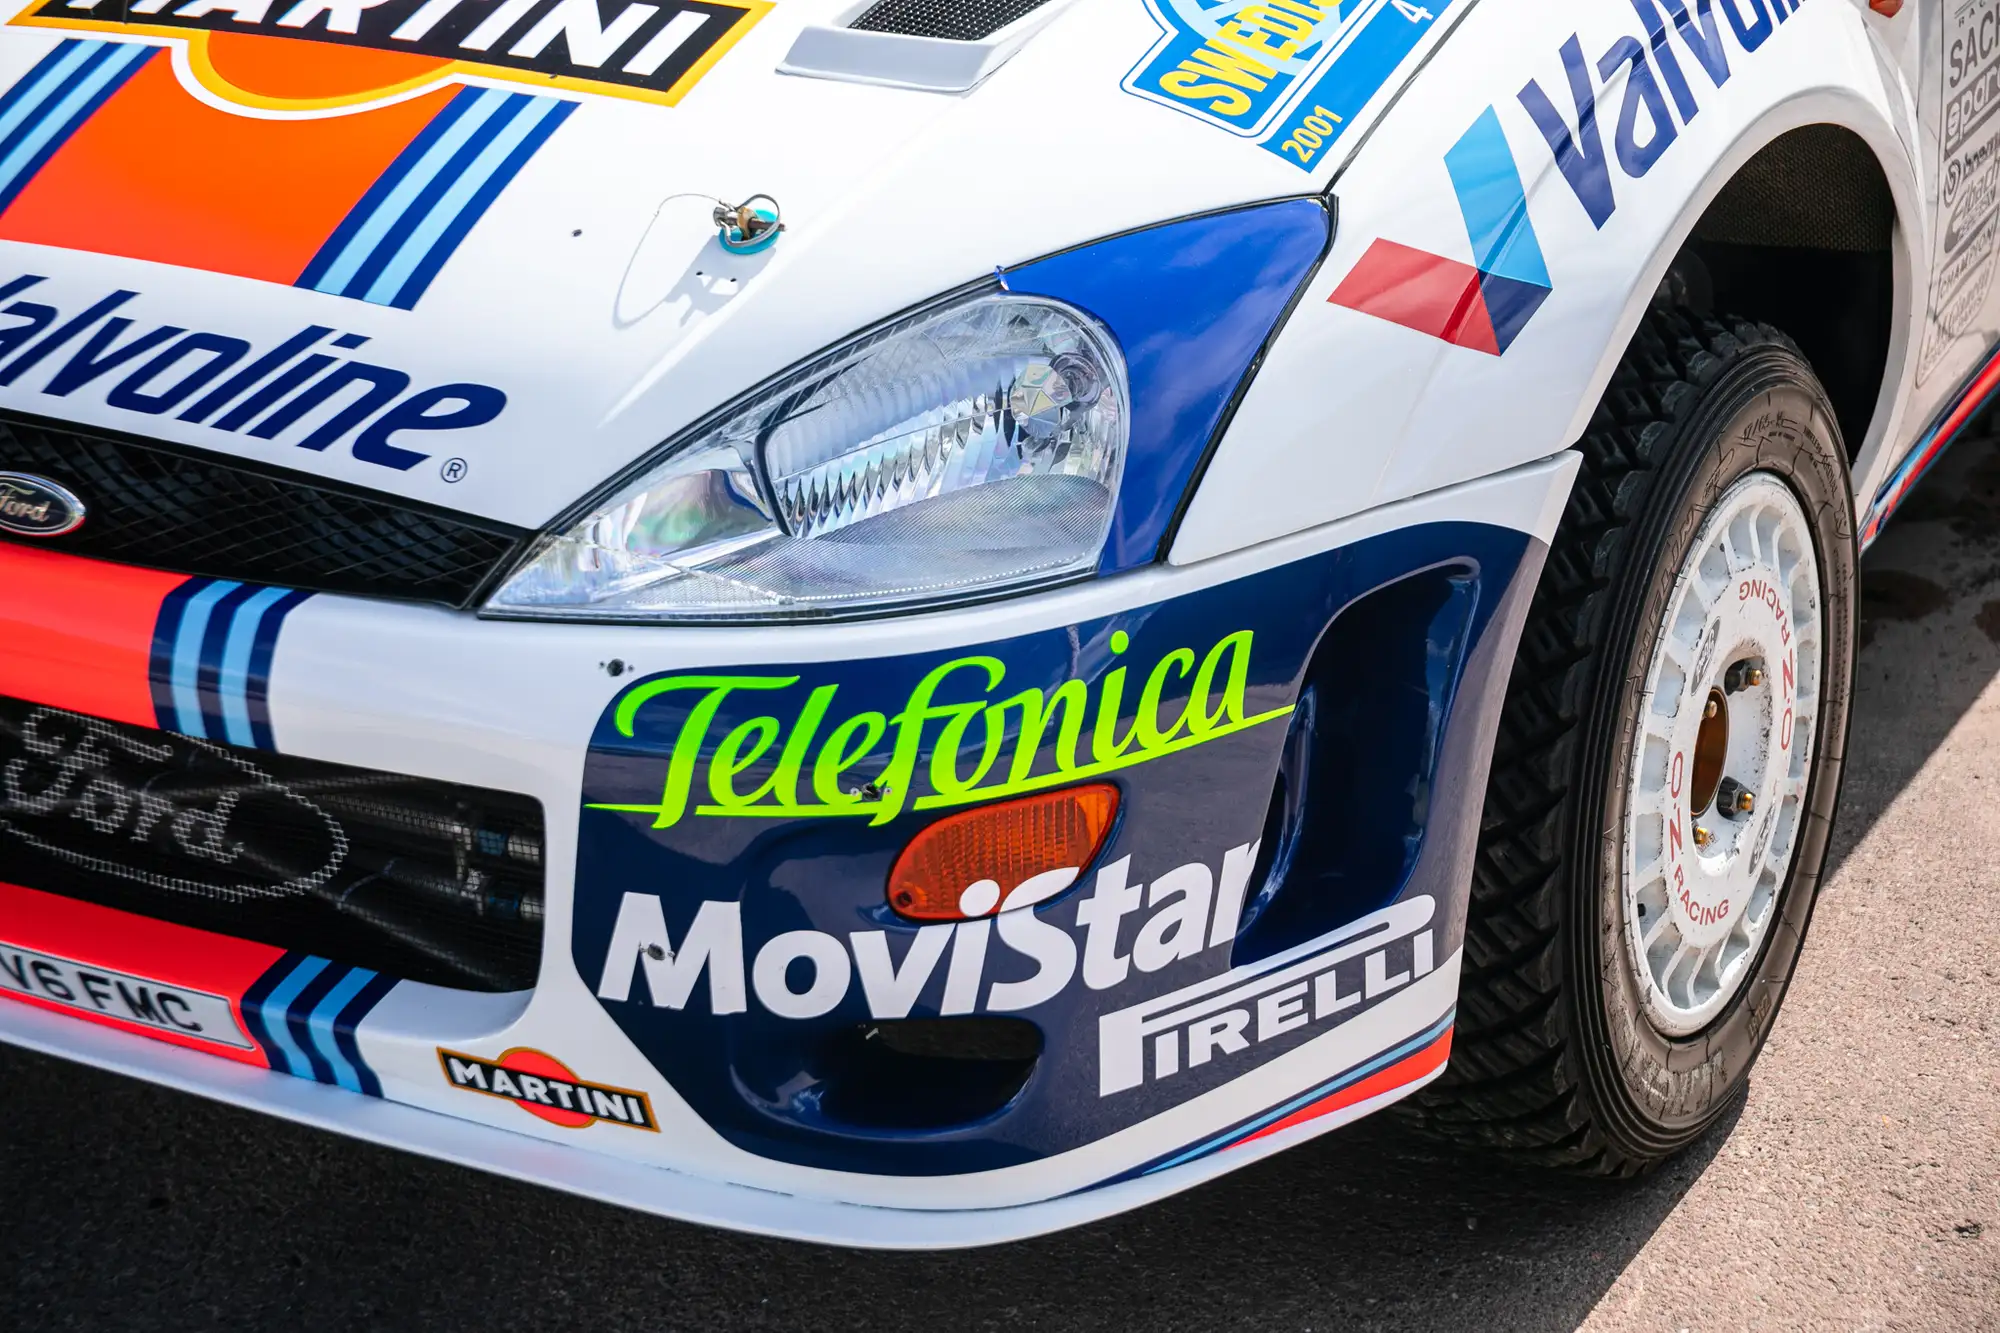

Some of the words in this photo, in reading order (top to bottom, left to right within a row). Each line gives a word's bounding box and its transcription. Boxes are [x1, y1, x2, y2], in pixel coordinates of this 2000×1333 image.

[68, 0, 693, 75] RTINI
[1159, 0, 1343, 117] SWEDI
[1281, 105, 1343, 164] 2001
[1516, 0, 1800, 231] Valvo
[1947, 66, 2000, 141] spar
[0, 273, 507, 471] alvoline
[1738, 579, 1791, 647] RACING
[5, 706, 245, 864] Ford
[598, 838, 1261, 1020] MoviStar
[1673, 863, 1730, 926] RACING
[0, 953, 76, 1002] V6
[76, 970, 204, 1033] FMC
[1099, 894, 1436, 1098] PIRELLI
[448, 1057, 646, 1125] MARTINI
